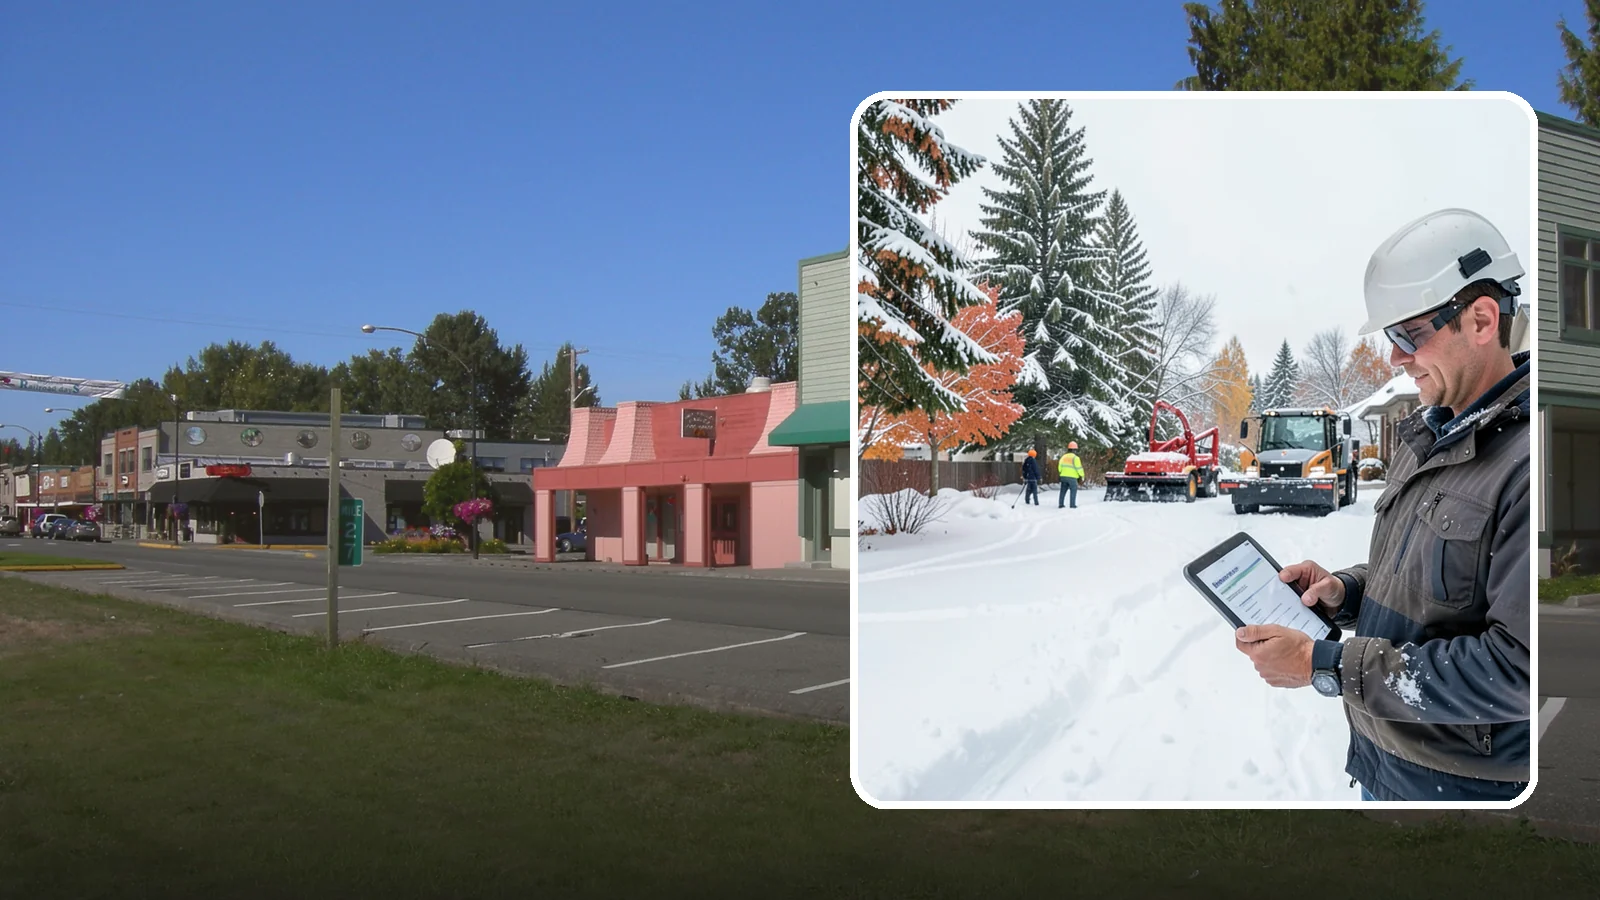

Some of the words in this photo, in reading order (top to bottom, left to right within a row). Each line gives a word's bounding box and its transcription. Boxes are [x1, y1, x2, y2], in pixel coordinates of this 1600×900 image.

[20, 379, 57, 392] Railroad
[341, 505, 362, 516] MILE
[345, 522, 356, 539] 2
[344, 543, 356, 560] 7
